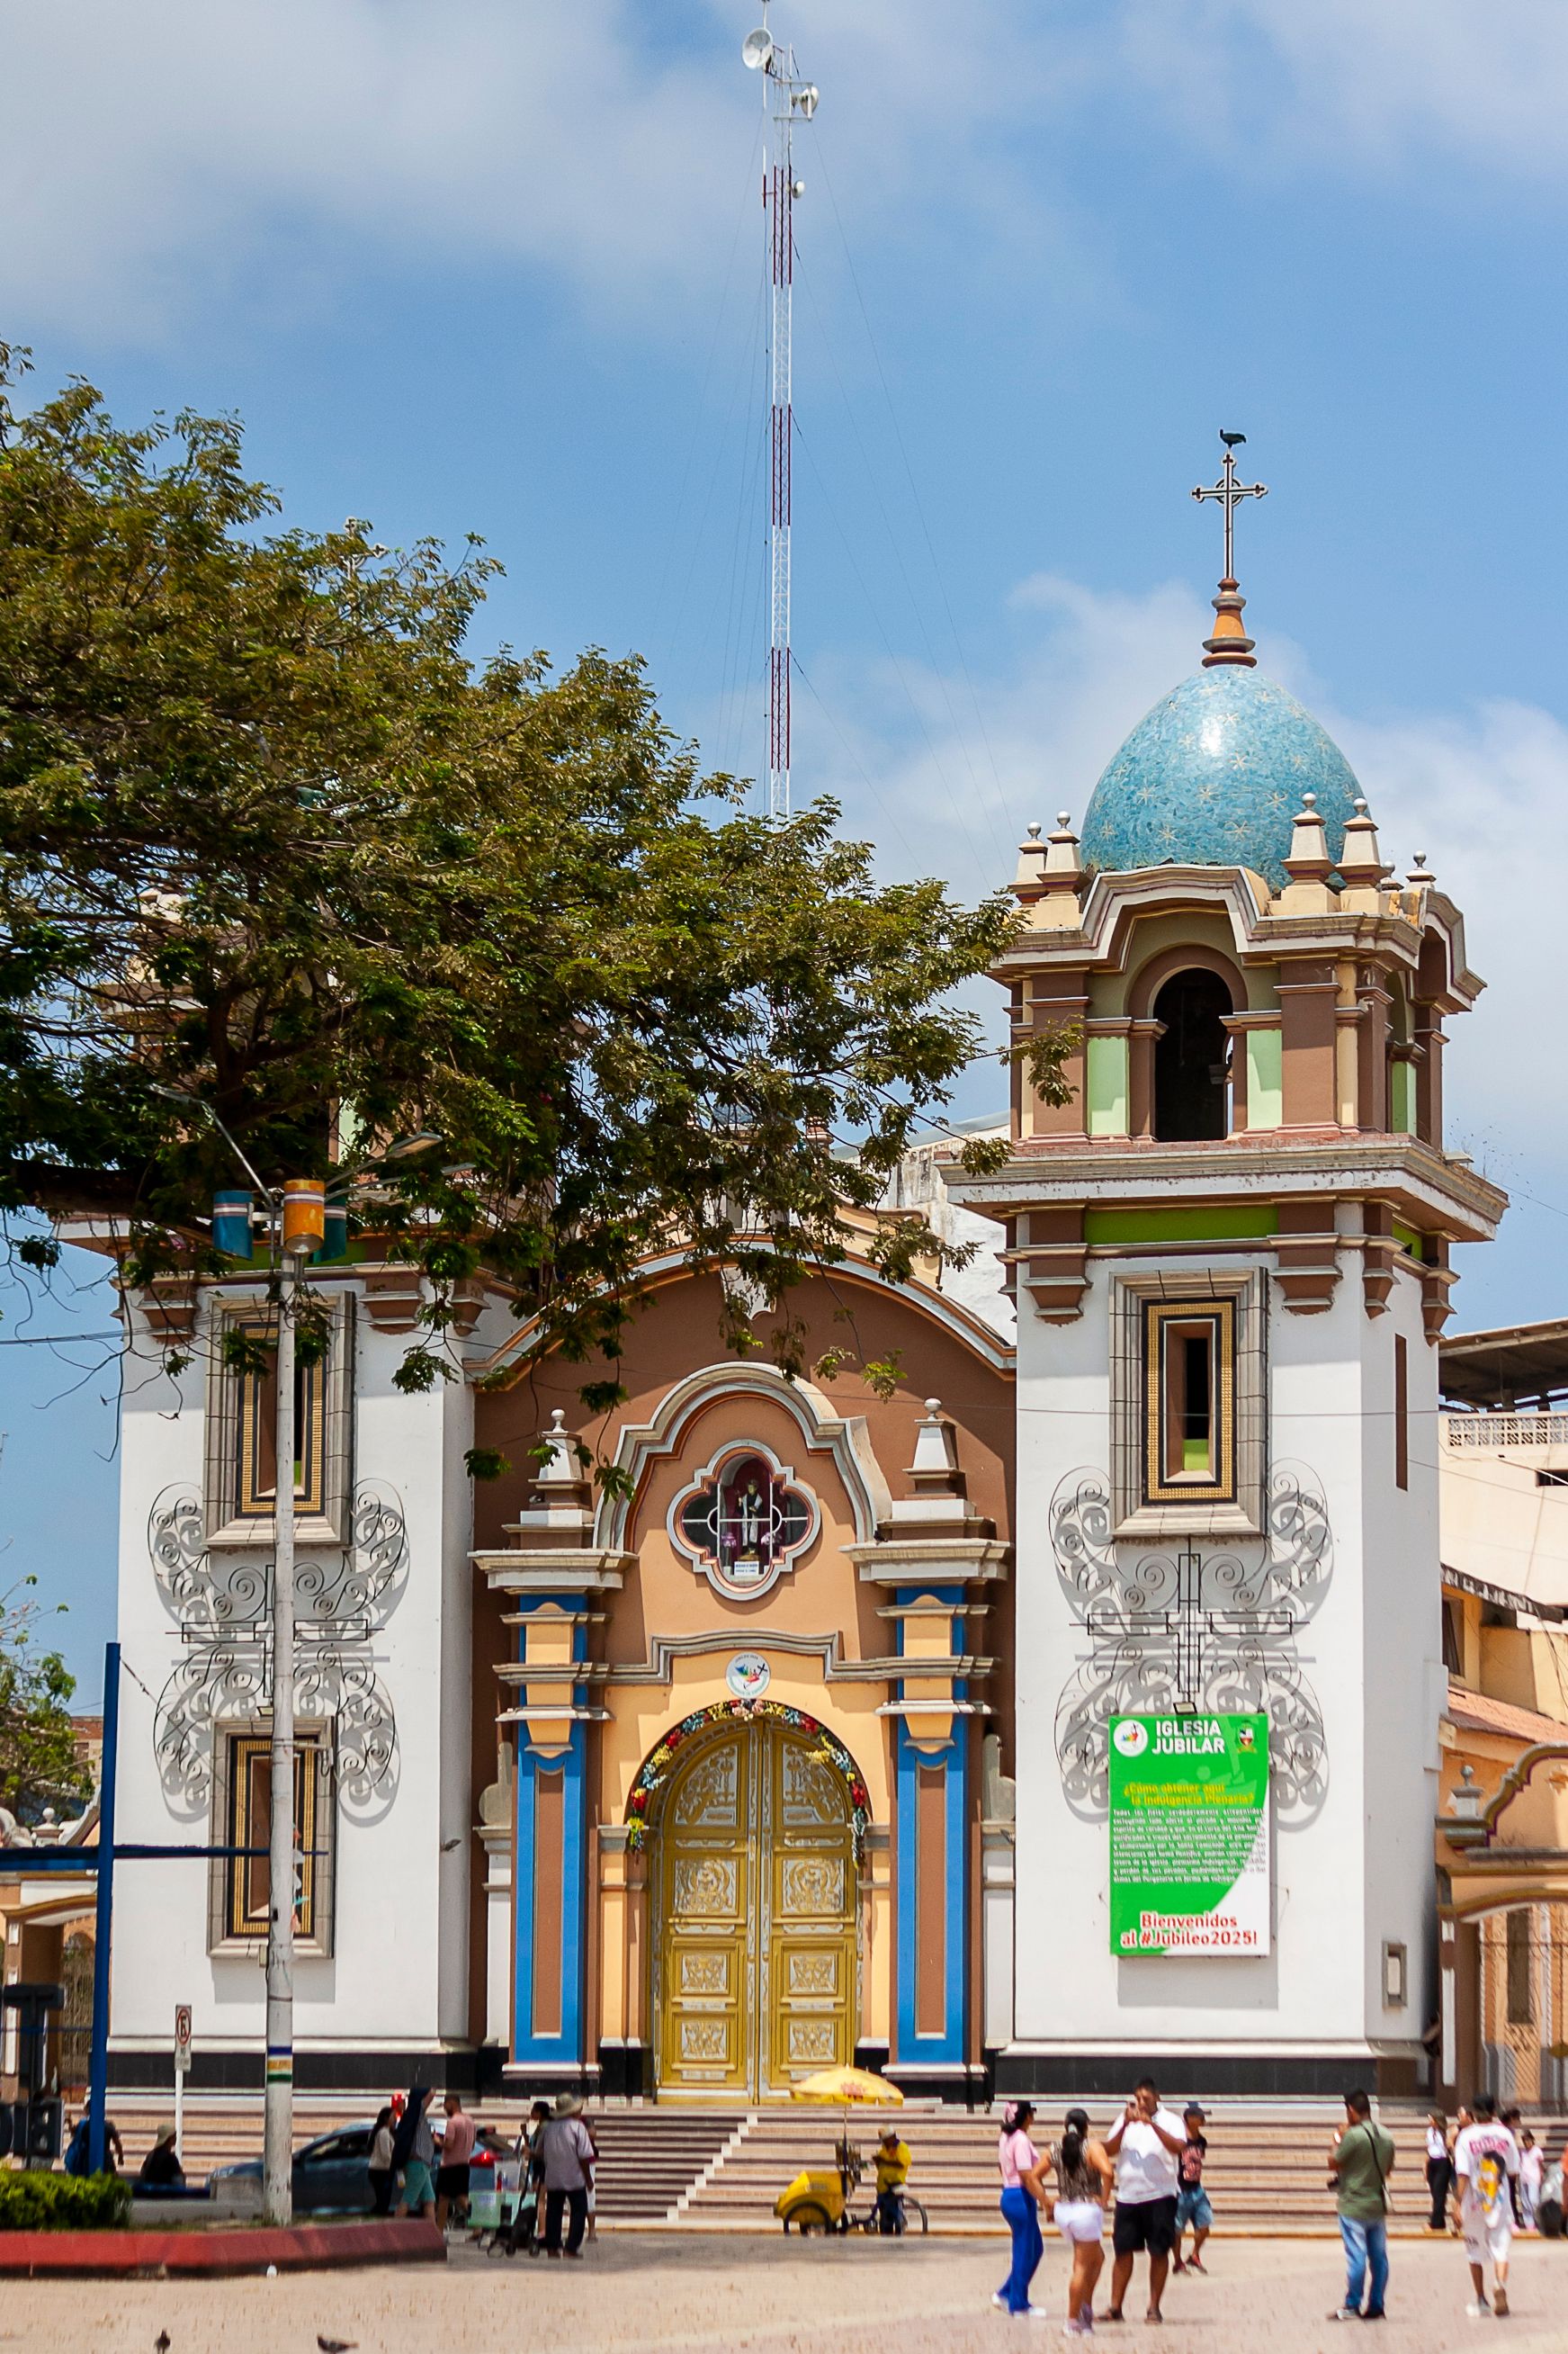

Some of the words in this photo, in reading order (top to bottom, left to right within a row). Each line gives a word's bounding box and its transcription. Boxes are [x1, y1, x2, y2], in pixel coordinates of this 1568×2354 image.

[1156, 1720, 1222, 1737] IGLESIA
[1151, 1738, 1225, 1755] JUBILAR
[1161, 1782, 1199, 1793] obtener
[1131, 1793, 1141, 1805] la
[1144, 1793, 1202, 1807] Indulgencia
[1141, 1913, 1238, 1928] Bienvenidos
[1122, 1930, 1135, 1945] al
[1140, 1930, 1259, 1945] #Jubileo2025!
